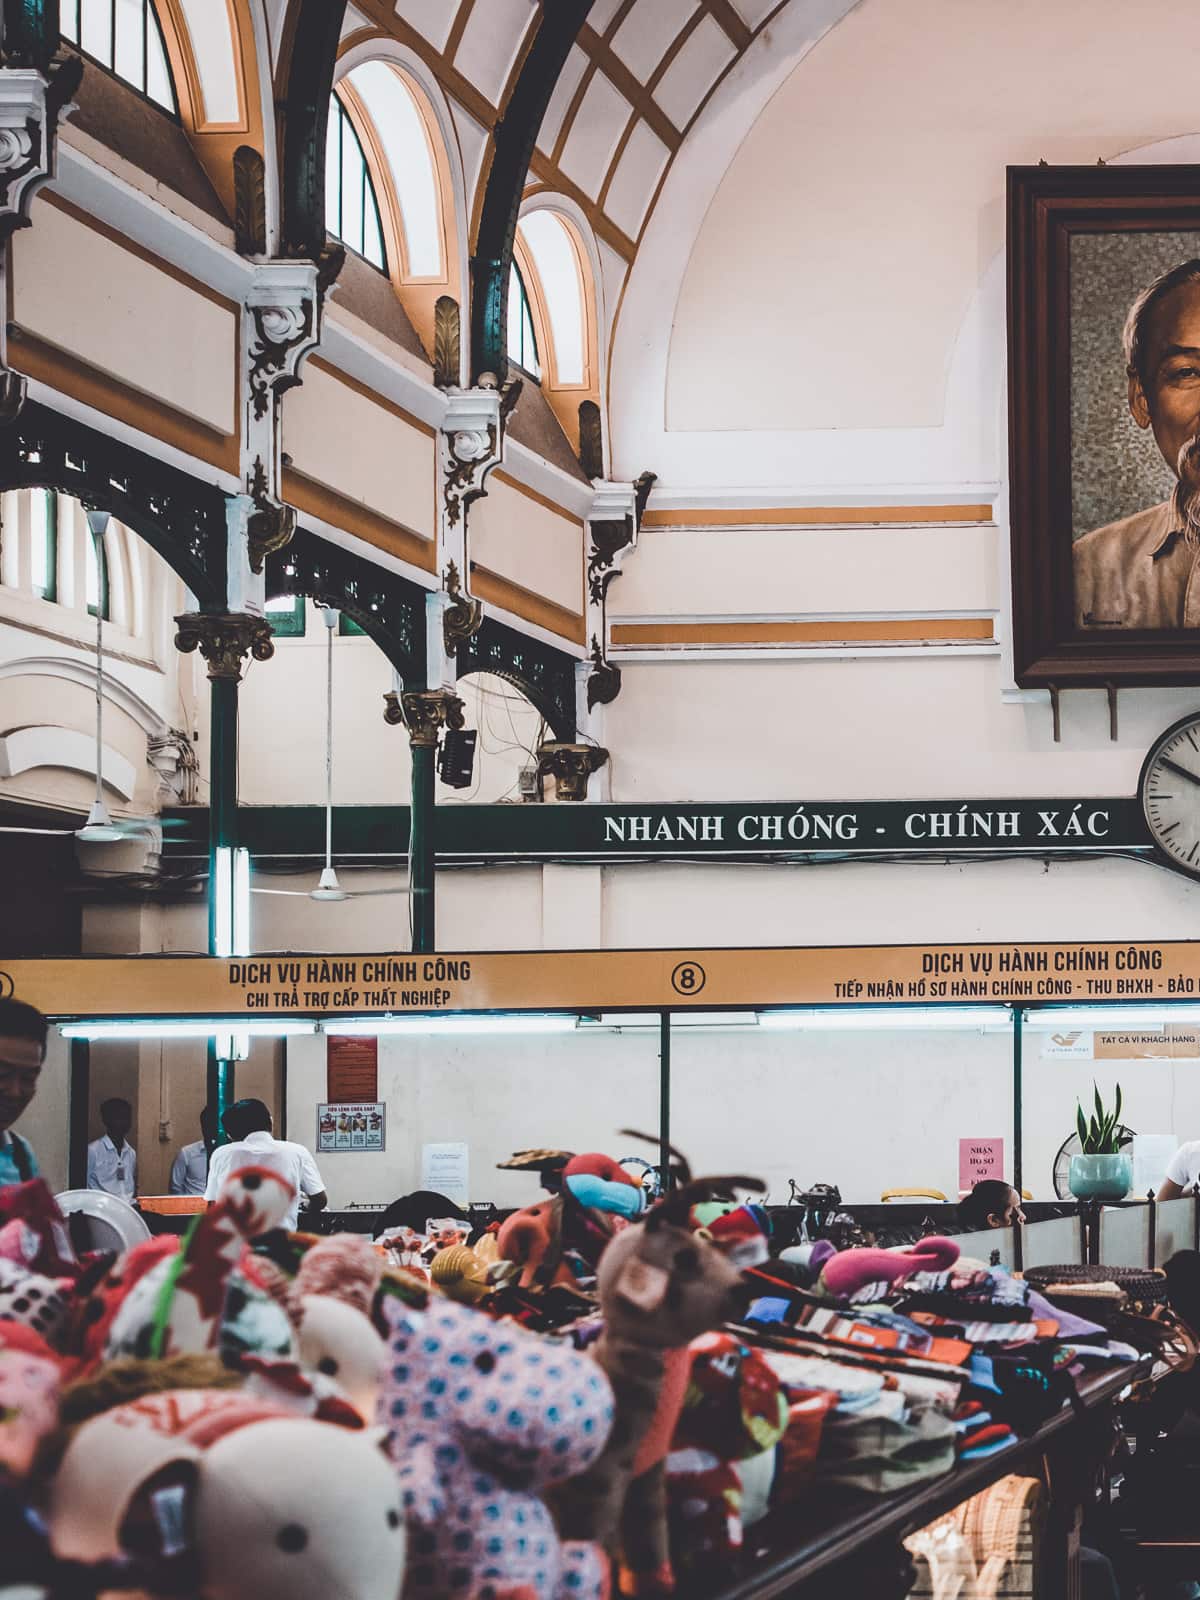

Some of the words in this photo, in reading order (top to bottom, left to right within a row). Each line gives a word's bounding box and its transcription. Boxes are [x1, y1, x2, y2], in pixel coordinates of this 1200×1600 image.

[604, 816, 724, 841] NHANH
[737, 806, 859, 840] CHÓNG
[904, 804, 1021, 838] CHÍNH
[1037, 803, 1110, 837] XÁC
[229, 963, 271, 988] DỊCH
[278, 963, 301, 987] VỤ
[307, 959, 356, 984] HÀNH
[362, 958, 417, 983] CHÍNH
[423, 958, 471, 982] CÔNG
[922, 953, 964, 976] DỊCH
[970, 953, 993, 976] VỤ
[999, 948, 1048, 973] HÀNH
[1054, 947, 1108, 971] CHÍNH
[1115, 947, 1162, 970] CÔNG
[246, 992, 269, 1008] CHI
[273, 987, 299, 1007] TRẢ
[303, 991, 329, 1010] TRỢ
[333, 987, 359, 1007] CẤP
[363, 987, 397, 1006] THẤT
[401, 988, 451, 1008] NGHIỆP
[834, 978, 863, 998] TIẾP
[867, 980, 904, 1000] NHẬN
[930, 981, 948, 996] SƠ
[951, 978, 988, 996] HÀNH
[992, 978, 1033, 995] CHÍNH
[1037, 977, 1072, 995] CÔNG
[1086, 979, 1112, 994] THU
[1117, 979, 1153, 994] BHXH
[1168, 974, 1194, 993] BẢO
